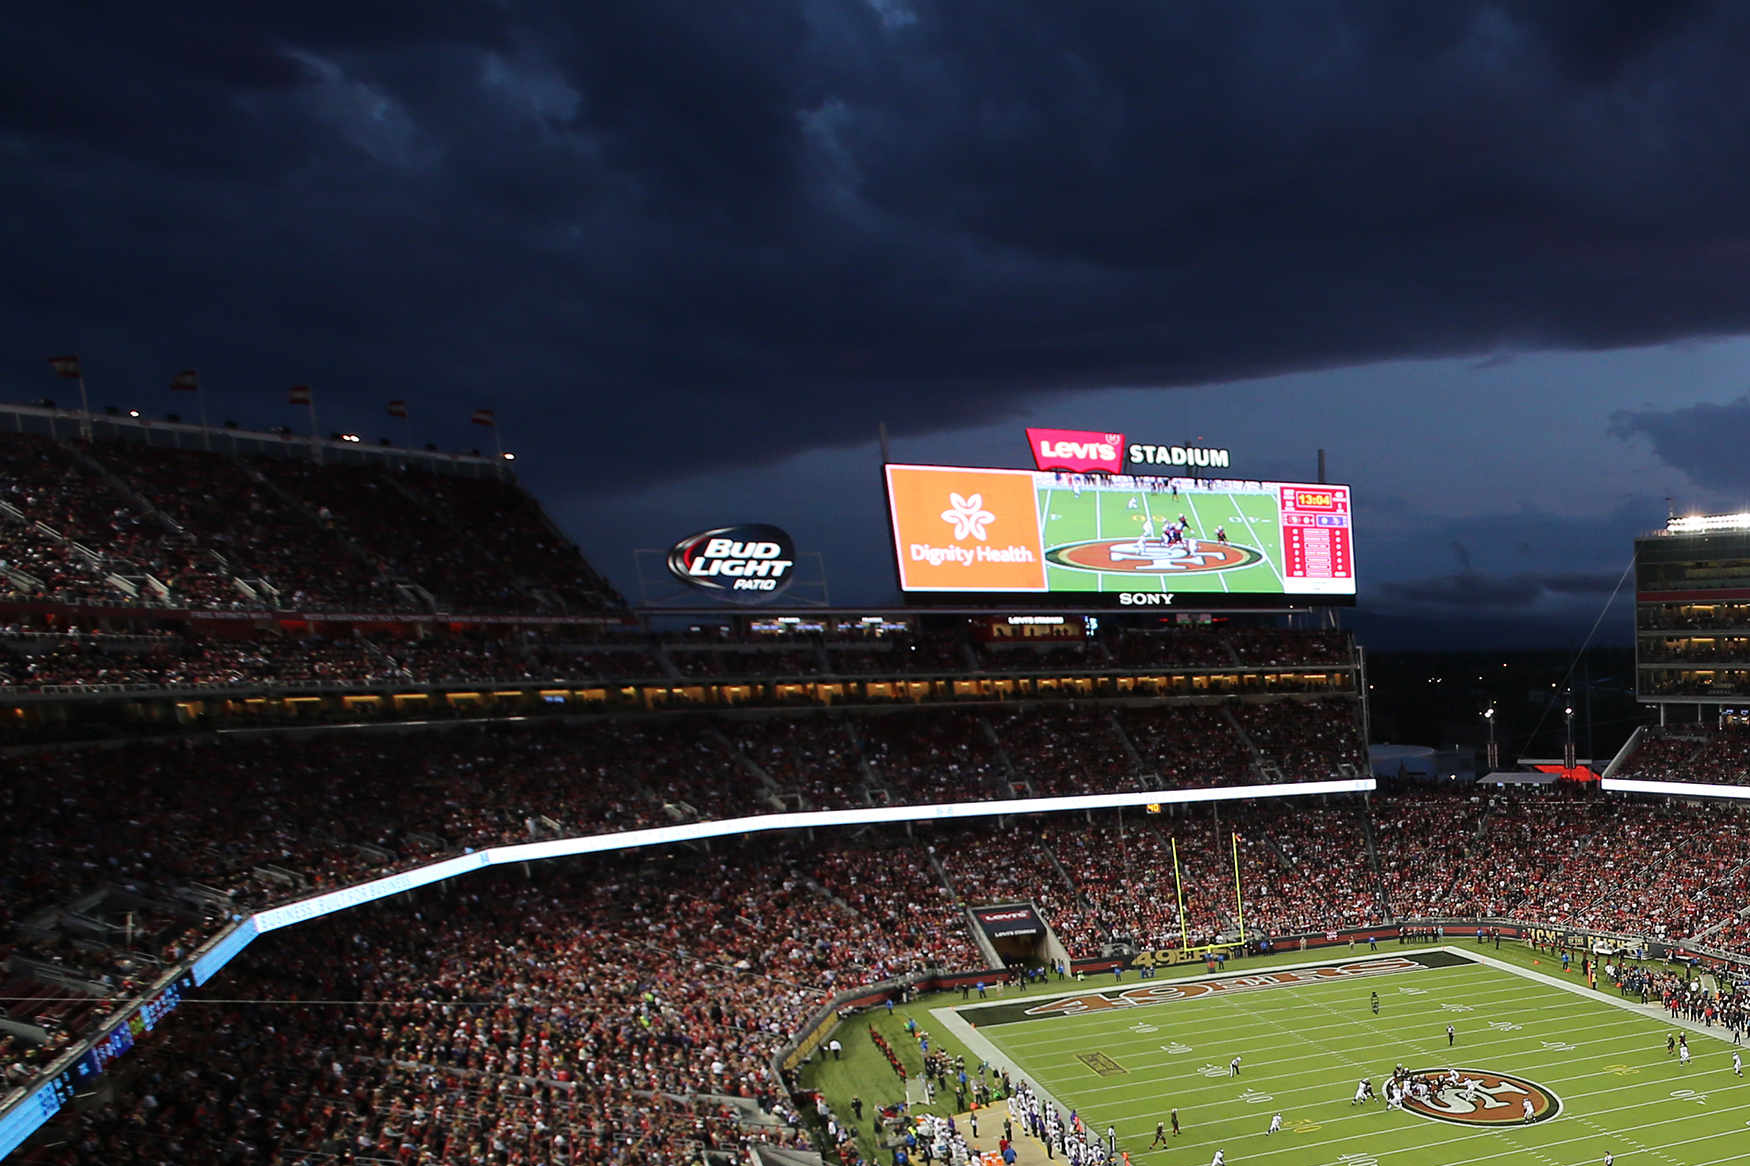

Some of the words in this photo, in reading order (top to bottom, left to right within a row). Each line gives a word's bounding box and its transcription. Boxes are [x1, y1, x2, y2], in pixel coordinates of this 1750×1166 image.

[1129, 444, 1230, 467] STADIUM
[1298, 493, 1331, 505] 13:04
[704, 539, 781, 559] BUD
[911, 544, 974, 566] Dignity
[977, 547, 1033, 562] Health
[689, 557, 793, 577] LIGHT
[733, 579, 777, 590] PATIO
[1119, 593, 1174, 605] SONY
[348, 886, 368, 902] FOR
